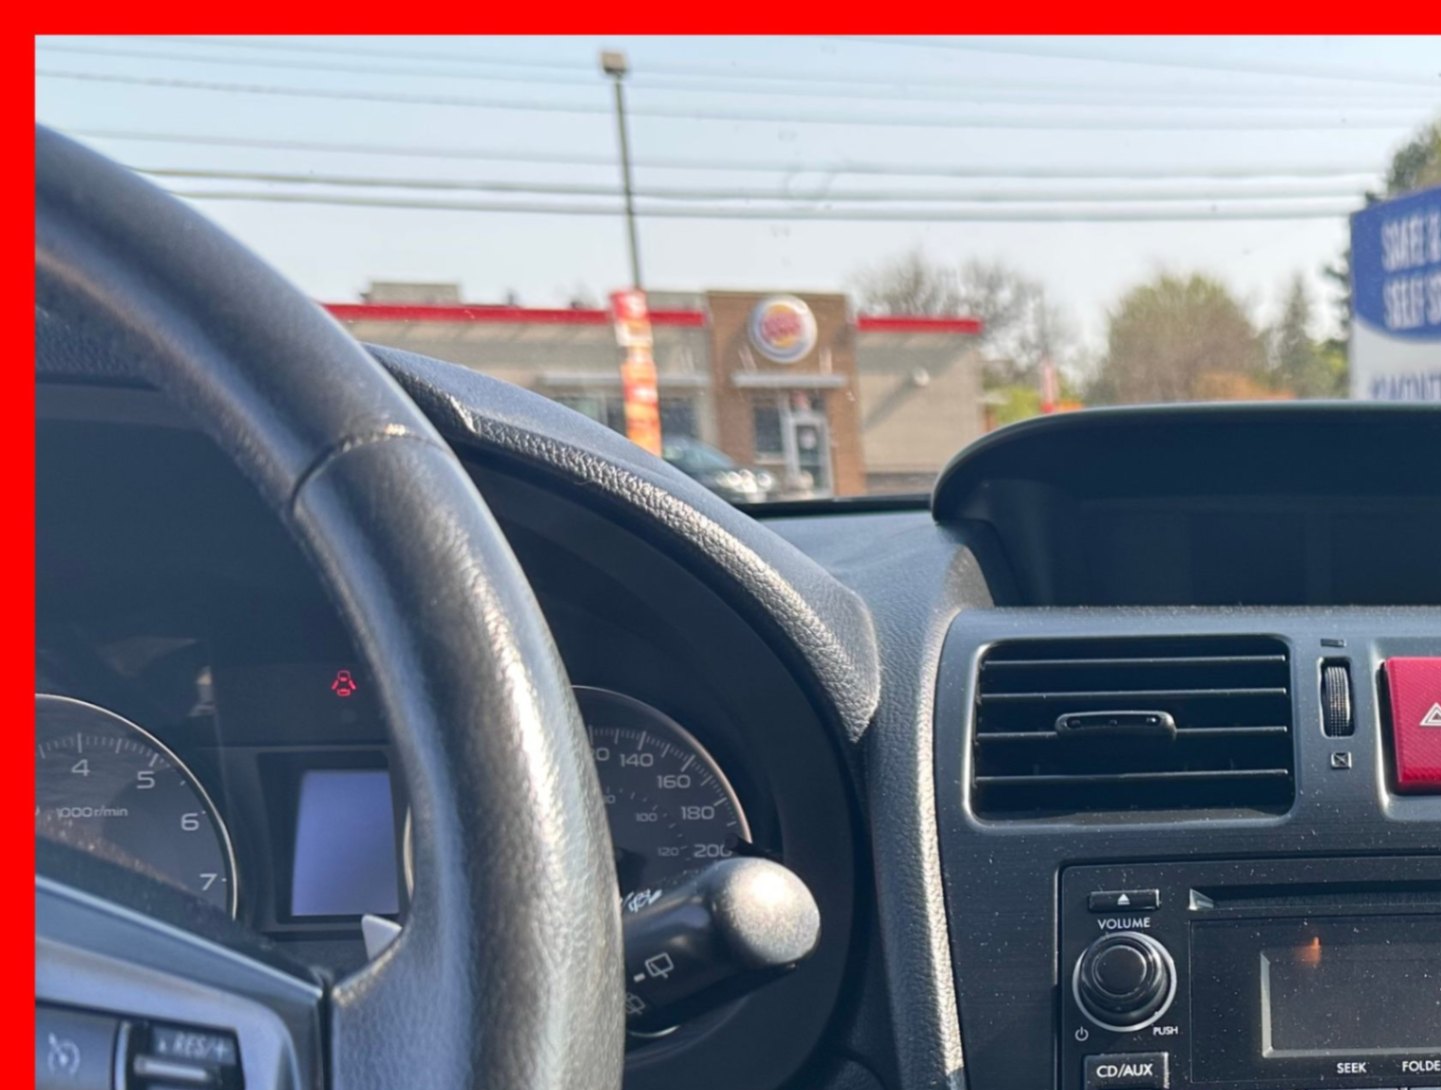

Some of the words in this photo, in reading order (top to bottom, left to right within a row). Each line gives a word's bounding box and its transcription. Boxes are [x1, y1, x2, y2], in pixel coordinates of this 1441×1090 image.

[620, 753, 654, 767] 140
[71, 759, 90, 777] 4
[136, 771, 155, 789] 5
[657, 774, 691, 789] 160
[636, 812, 658, 822] 100
[681, 806, 715, 820] 180
[180, 813, 200, 832] 6
[658, 847, 679, 857] 120
[199, 873, 218, 892] 7
[1097, 917, 1151, 930] VOLUME
[1153, 1026, 1178, 1036] PUSH
[1096, 1063, 1153, 1078] CD/AUX
[1337, 1062, 1367, 1074] SEEK
